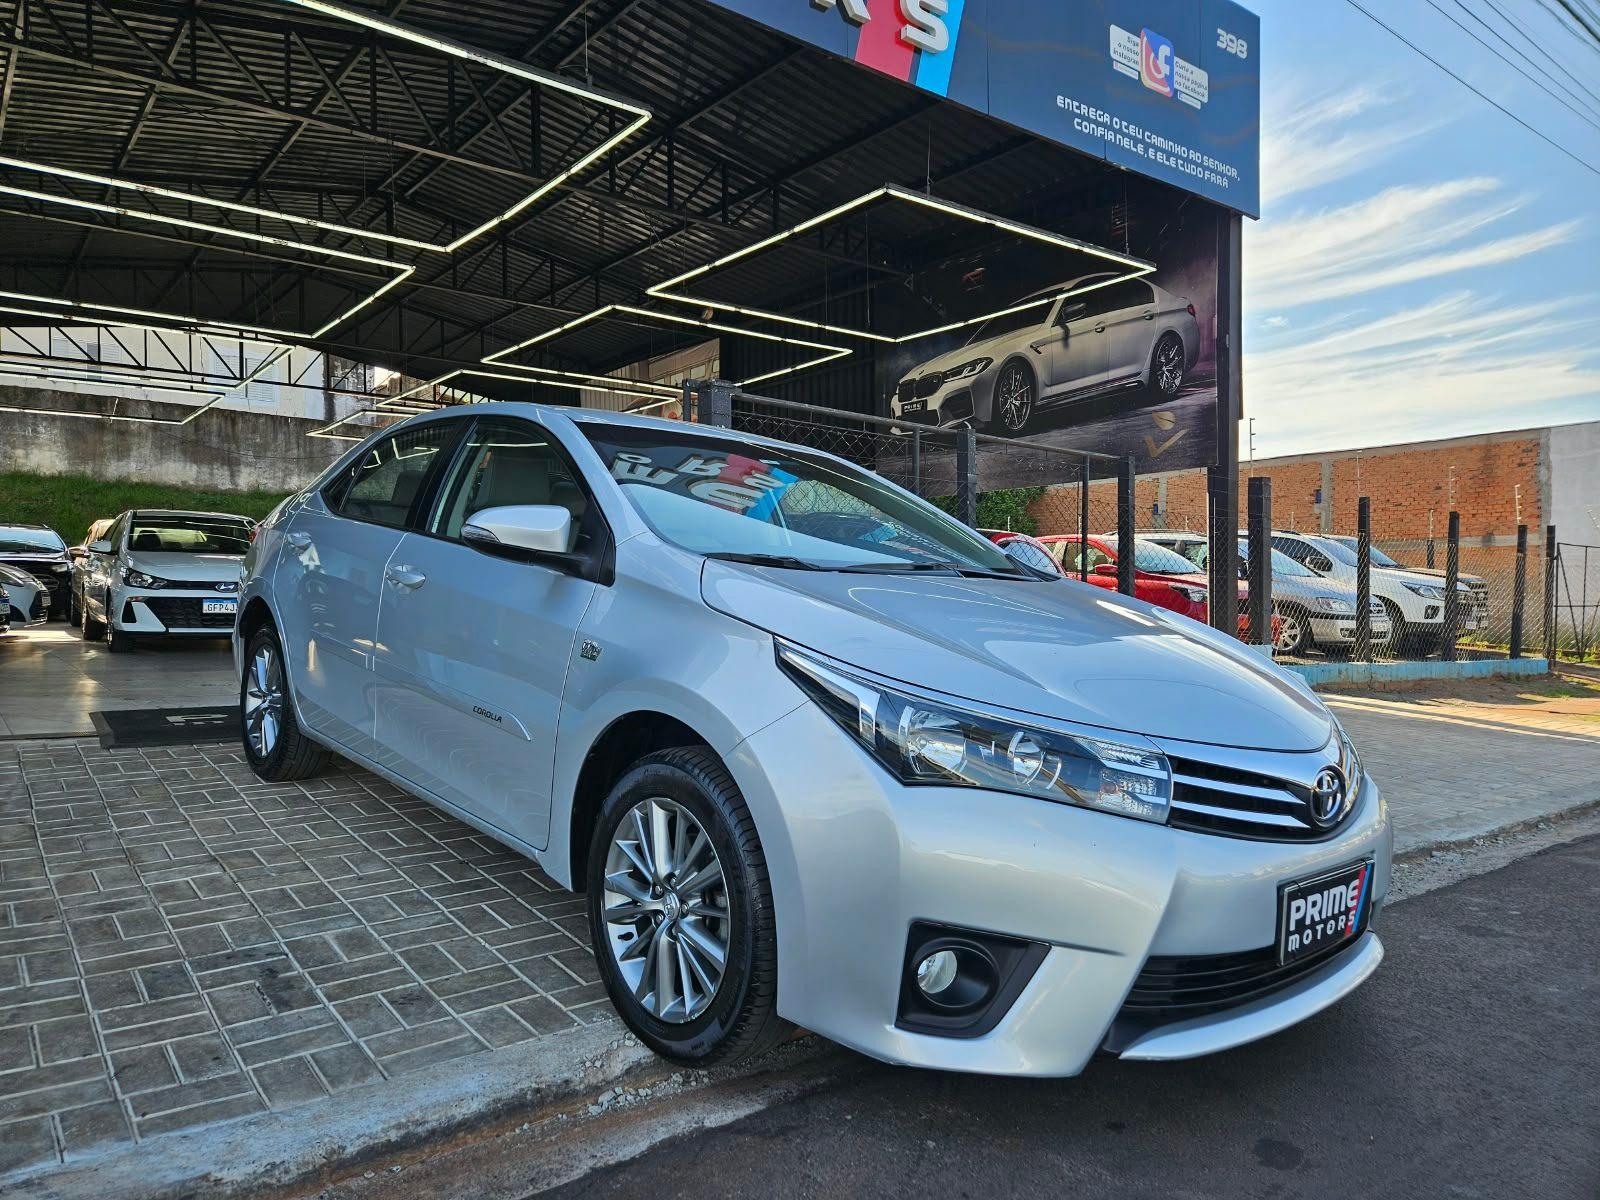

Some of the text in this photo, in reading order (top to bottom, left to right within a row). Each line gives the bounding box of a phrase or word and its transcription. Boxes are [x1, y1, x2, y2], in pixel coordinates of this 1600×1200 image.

[1122, 45, 1140, 57] nosso
[1127, 36, 1140, 47] Siga
[1216, 28, 1248, 59] 398
[1182, 82, 1205, 98] facebook
[1056, 94, 1240, 182] ENTREGA O TEU CAMINHO AO SENHOR,
[1073, 117, 1229, 189] CONFIA NELE, E ELE TUDO FARÁ
[207, 603, 238, 612] GFP4J
[472, 705, 502, 723] COROLLA
[1289, 879, 1360, 931] PRIME
[1287, 910, 1356, 953] MOTORS
